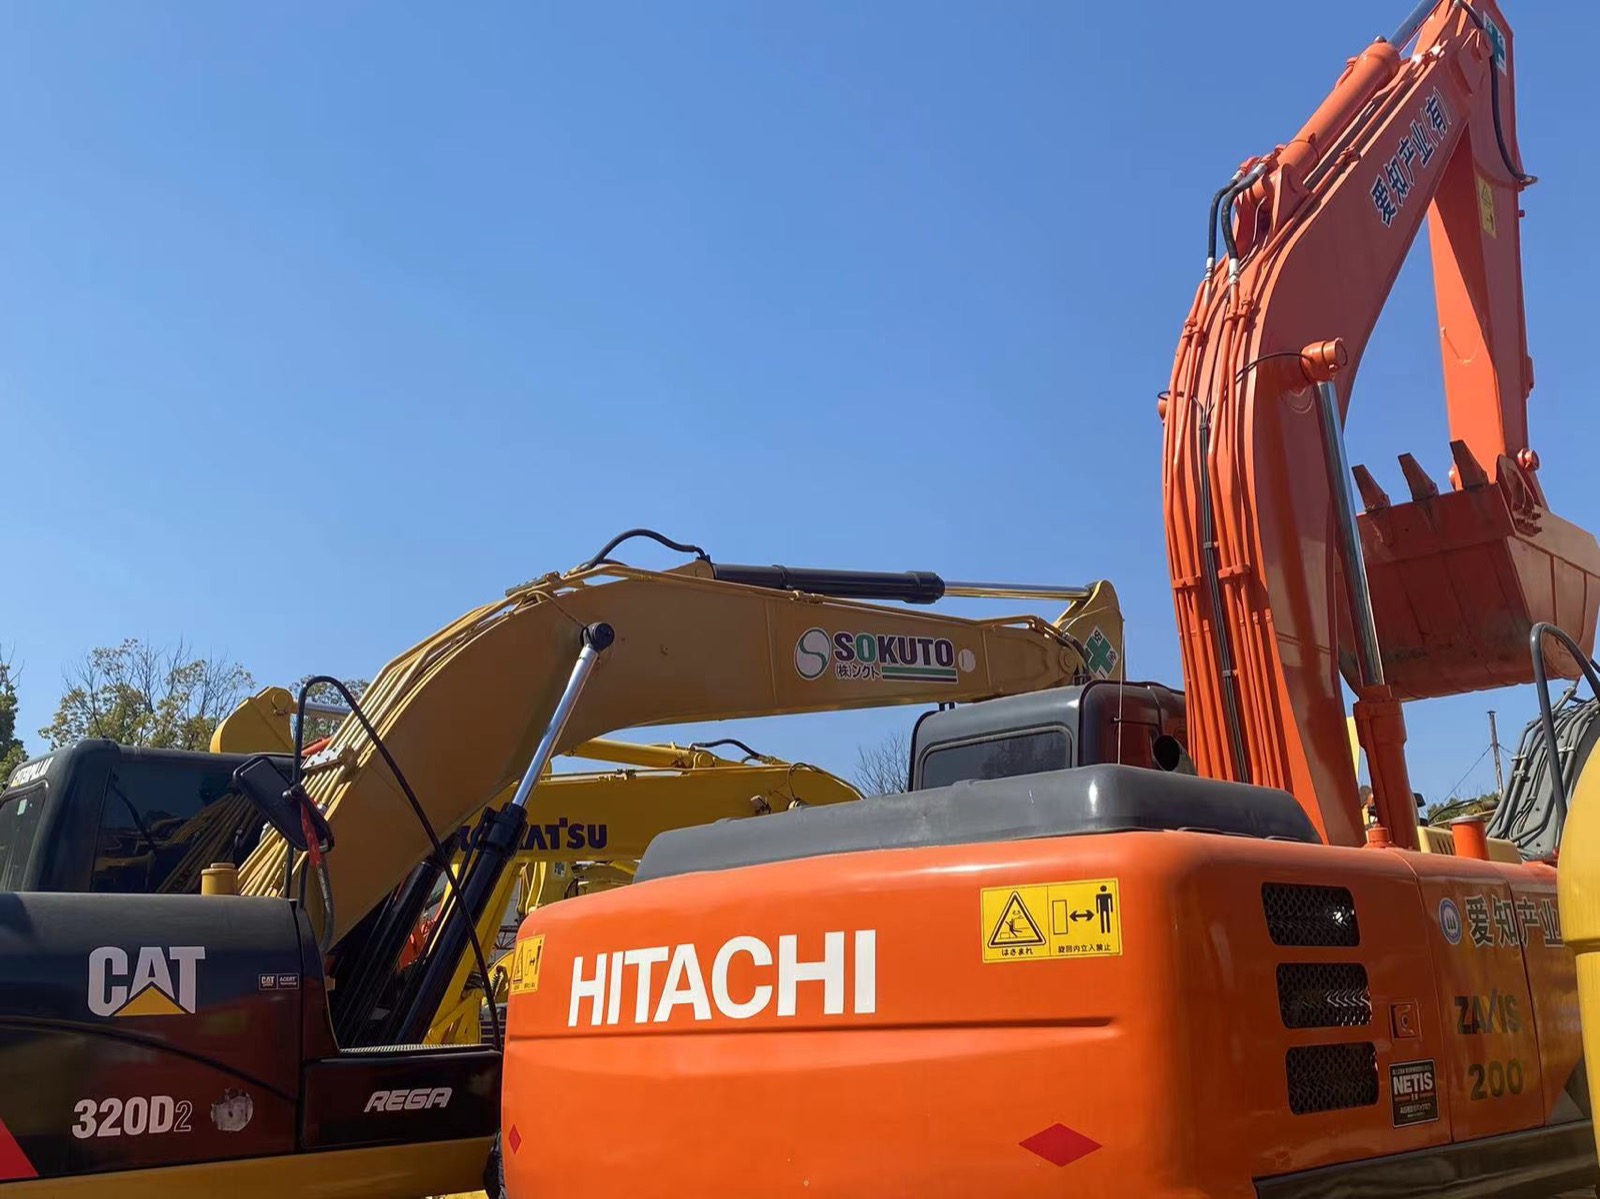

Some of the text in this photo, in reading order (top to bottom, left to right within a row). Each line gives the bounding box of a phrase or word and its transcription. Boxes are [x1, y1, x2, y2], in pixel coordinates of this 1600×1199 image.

[834, 632, 955, 667] SOKUTO
[458, 818, 607, 850] KATSU
[87, 946, 206, 1017] CAT
[261, 976, 275, 984] CAT
[567, 929, 877, 1027] HITACHI
[1454, 988, 1521, 1035] ZAXIS
[1393, 1072, 1433, 1095] NETIS
[1468, 1058, 1524, 1101] 200
[72, 1095, 193, 1139] 320D2
[363, 1087, 453, 1113] REGA
